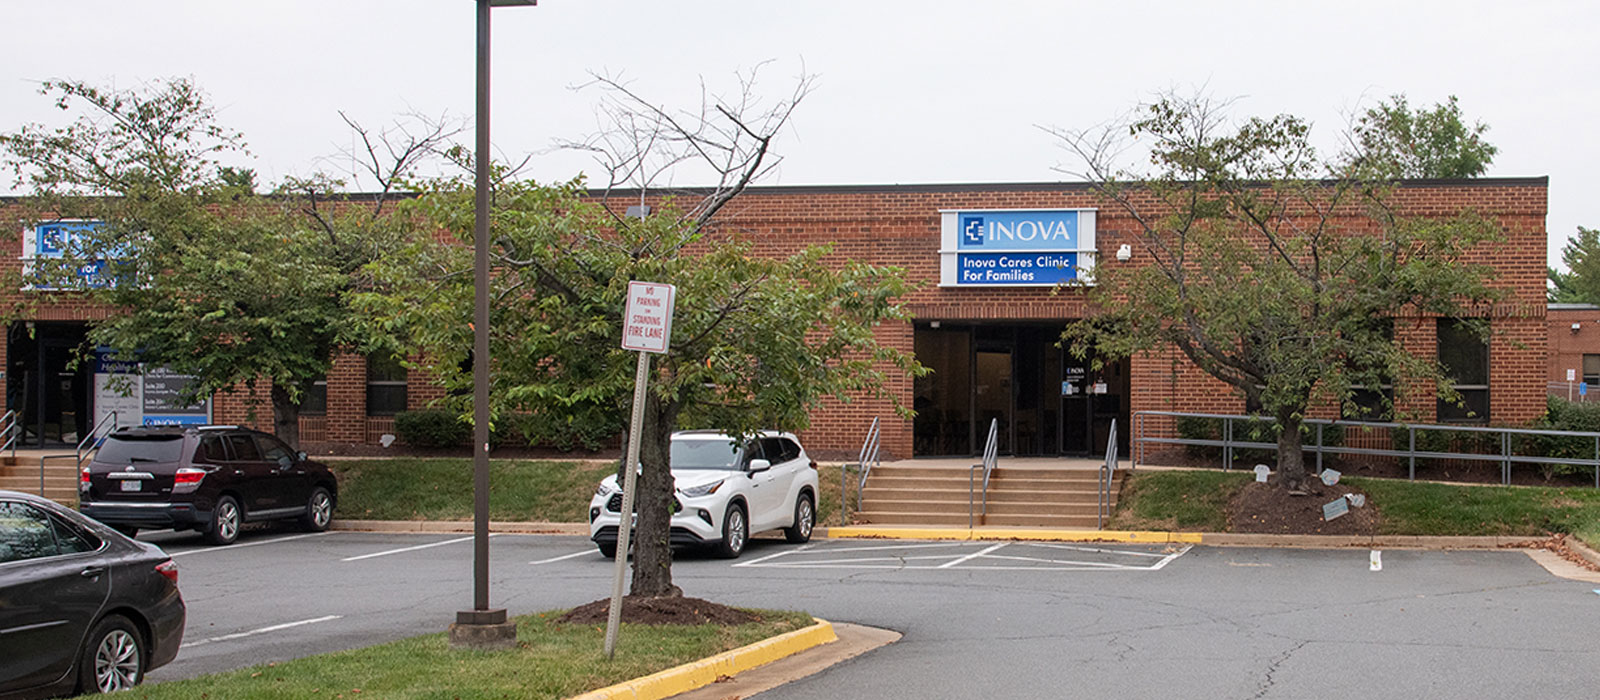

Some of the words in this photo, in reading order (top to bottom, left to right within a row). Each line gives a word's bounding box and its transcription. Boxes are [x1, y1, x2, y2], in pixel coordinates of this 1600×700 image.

[989, 220, 1070, 241] INOVA
[963, 257, 996, 268] Inova
[999, 256, 1033, 268] Cares
[1036, 256, 1070, 267] Clinic
[963, 270, 983, 281] For
[986, 269, 1034, 281] Families
[636, 296, 662, 307] PARKING
[632, 314, 662, 326] STANDING
[628, 325, 644, 338] FIRE
[644, 327, 663, 340] LANE
